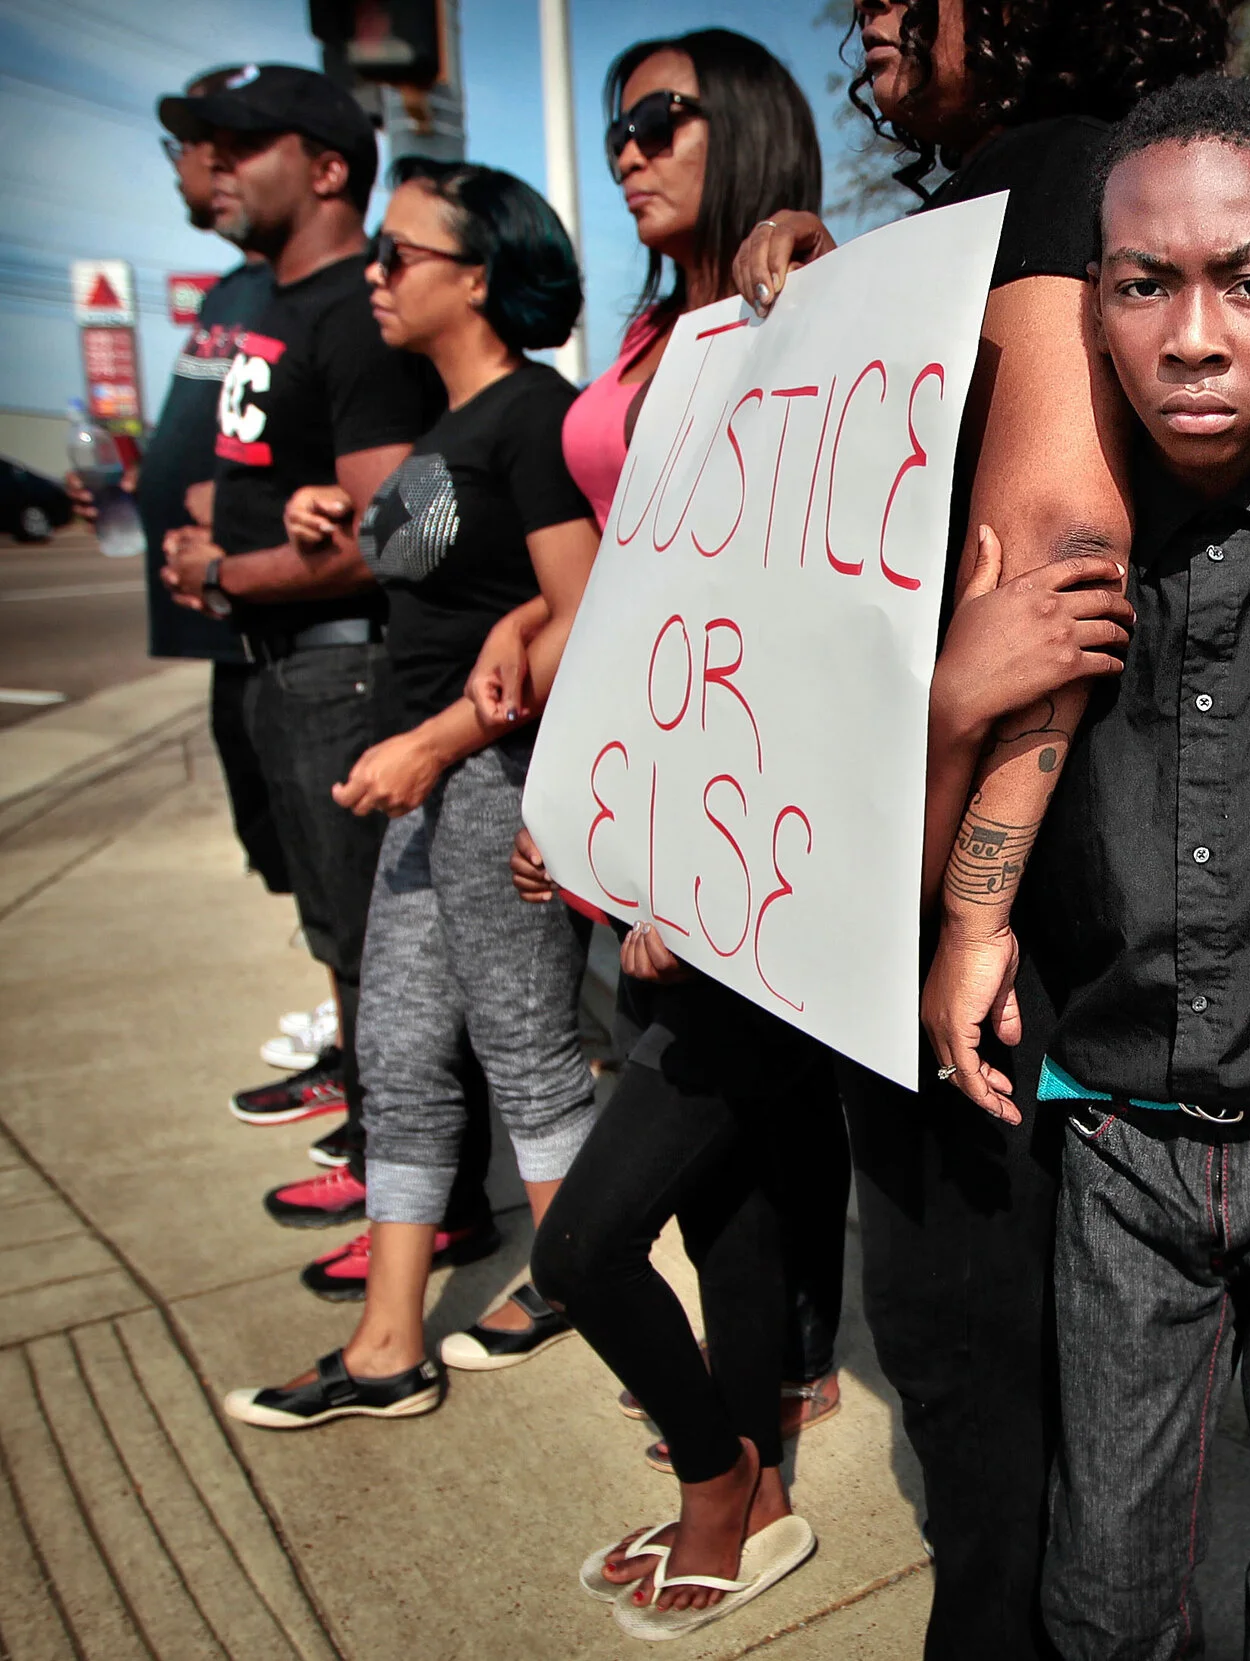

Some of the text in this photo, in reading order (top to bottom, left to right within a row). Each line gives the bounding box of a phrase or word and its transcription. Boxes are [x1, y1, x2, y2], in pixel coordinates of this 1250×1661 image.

[616, 318, 945, 591] JUSTICE
[647, 614, 763, 774] OR
[587, 740, 812, 1012] ELSE
